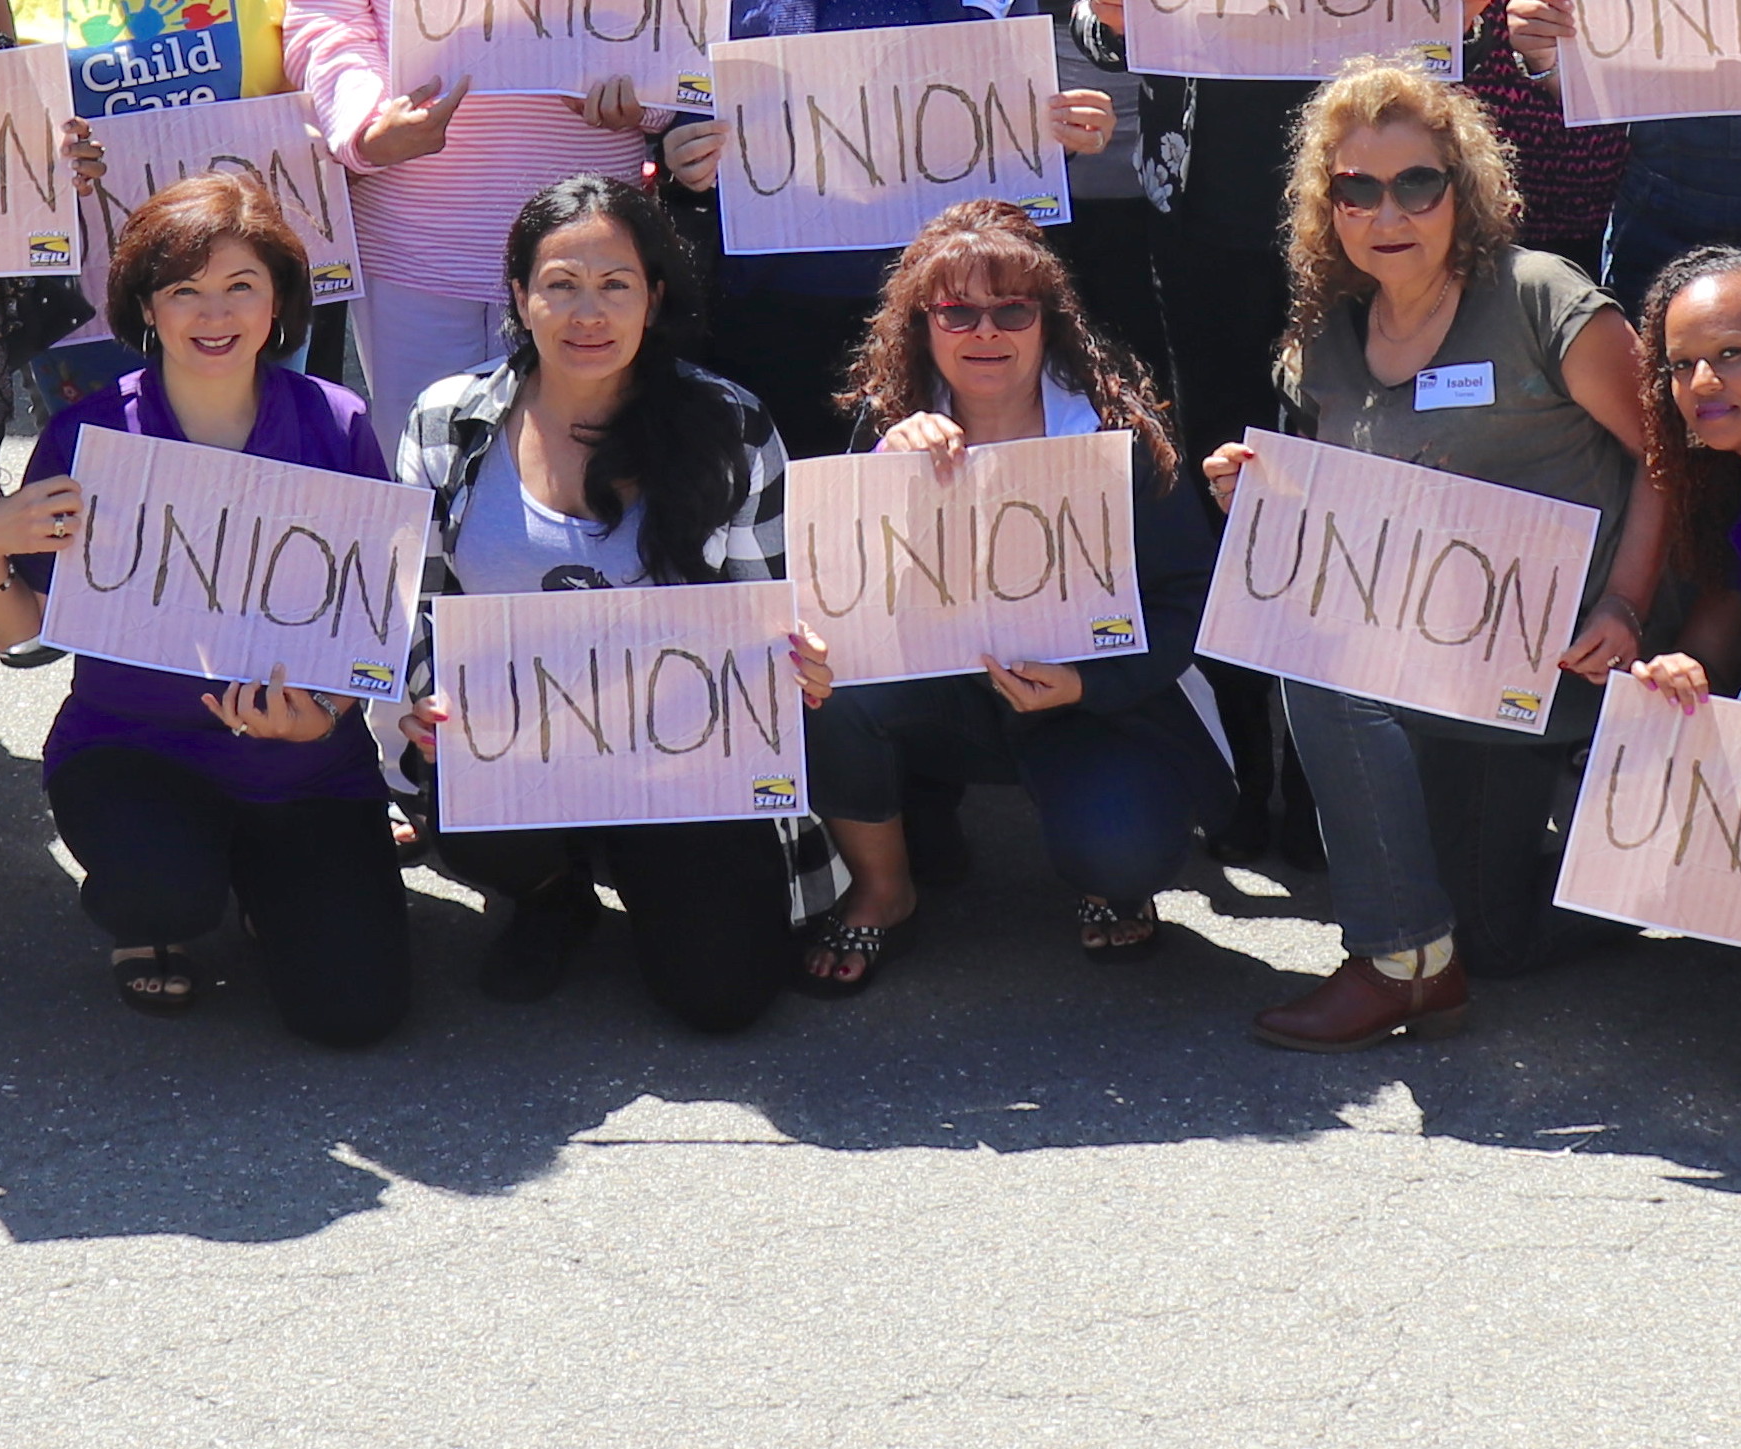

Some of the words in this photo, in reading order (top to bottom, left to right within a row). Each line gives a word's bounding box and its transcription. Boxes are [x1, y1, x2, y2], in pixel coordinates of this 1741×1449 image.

[81, 30, 222, 92] Child
[736, 79, 1043, 196] UNION
[31, 252, 68, 262] SEIU
[314, 278, 351, 292] SEIU
[1446, 376, 1483, 388] Isabel
[808, 491, 1115, 618] UNION
[83, 495, 397, 645] UNION
[1245, 498, 1559, 673] UNION
[1095, 635, 1132, 646] SEIU
[351, 677, 390, 689] SEIU
[459, 646, 780, 763] UNION
[1498, 708, 1536, 719] SEIU
[755, 795, 794, 806] SEIU
